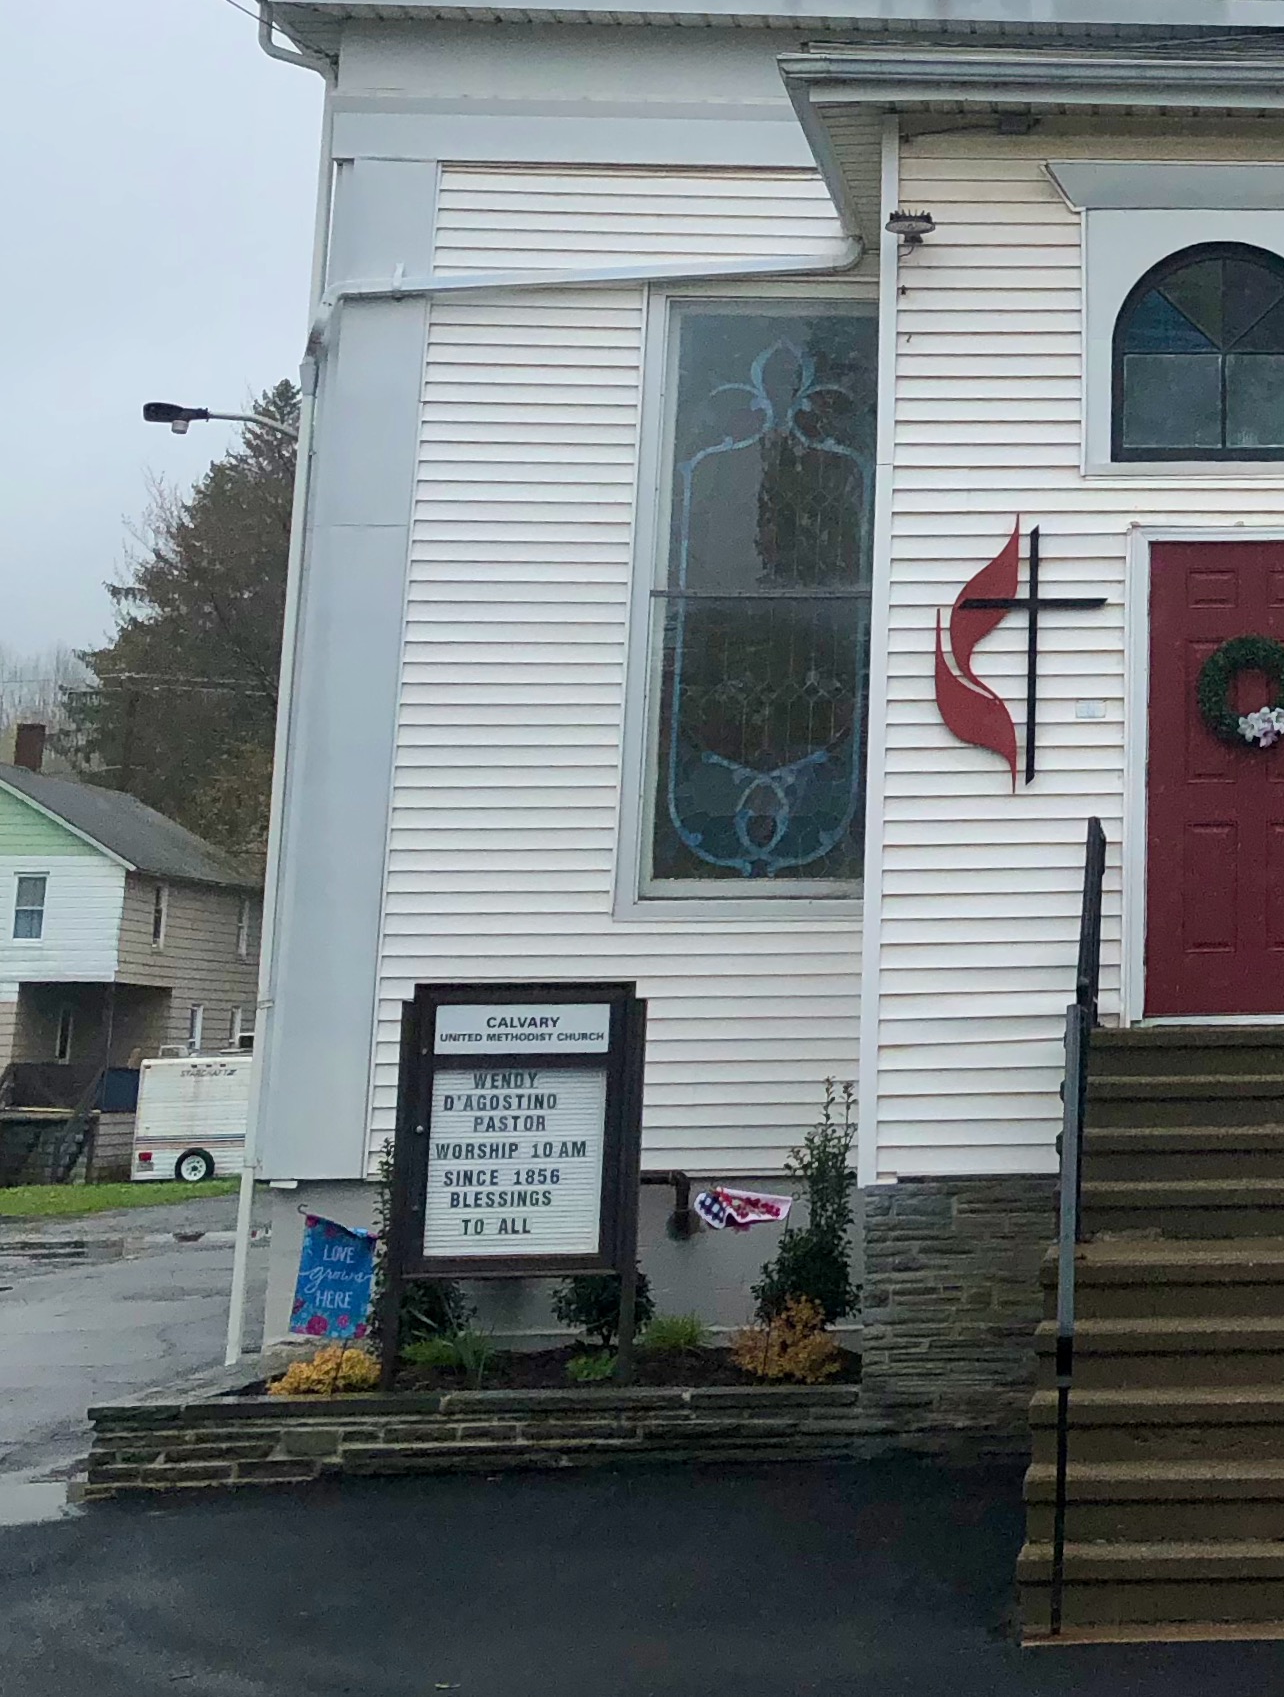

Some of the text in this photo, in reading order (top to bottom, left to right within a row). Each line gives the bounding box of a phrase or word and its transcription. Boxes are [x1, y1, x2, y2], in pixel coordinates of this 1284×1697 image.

[486, 1016, 560, 1029] CALVARY
[440, 1032, 605, 1043] UNITED METHODIST CHURCH
[473, 1071, 538, 1090] WENDY
[443, 1093, 558, 1112] D'AGOSTINO
[473, 1115, 547, 1133] PASTOR
[435, 1142, 520, 1160] WORSHIP
[443, 1168, 561, 1187] SINCE 1856
[450, 1190, 553, 1209] BLESSINGS
[462, 1217, 531, 1236] TO ALL
[322, 1244, 356, 1264] LOVE
[299, 1266, 373, 1294] grows
[315, 1289, 353, 1309] HERE
